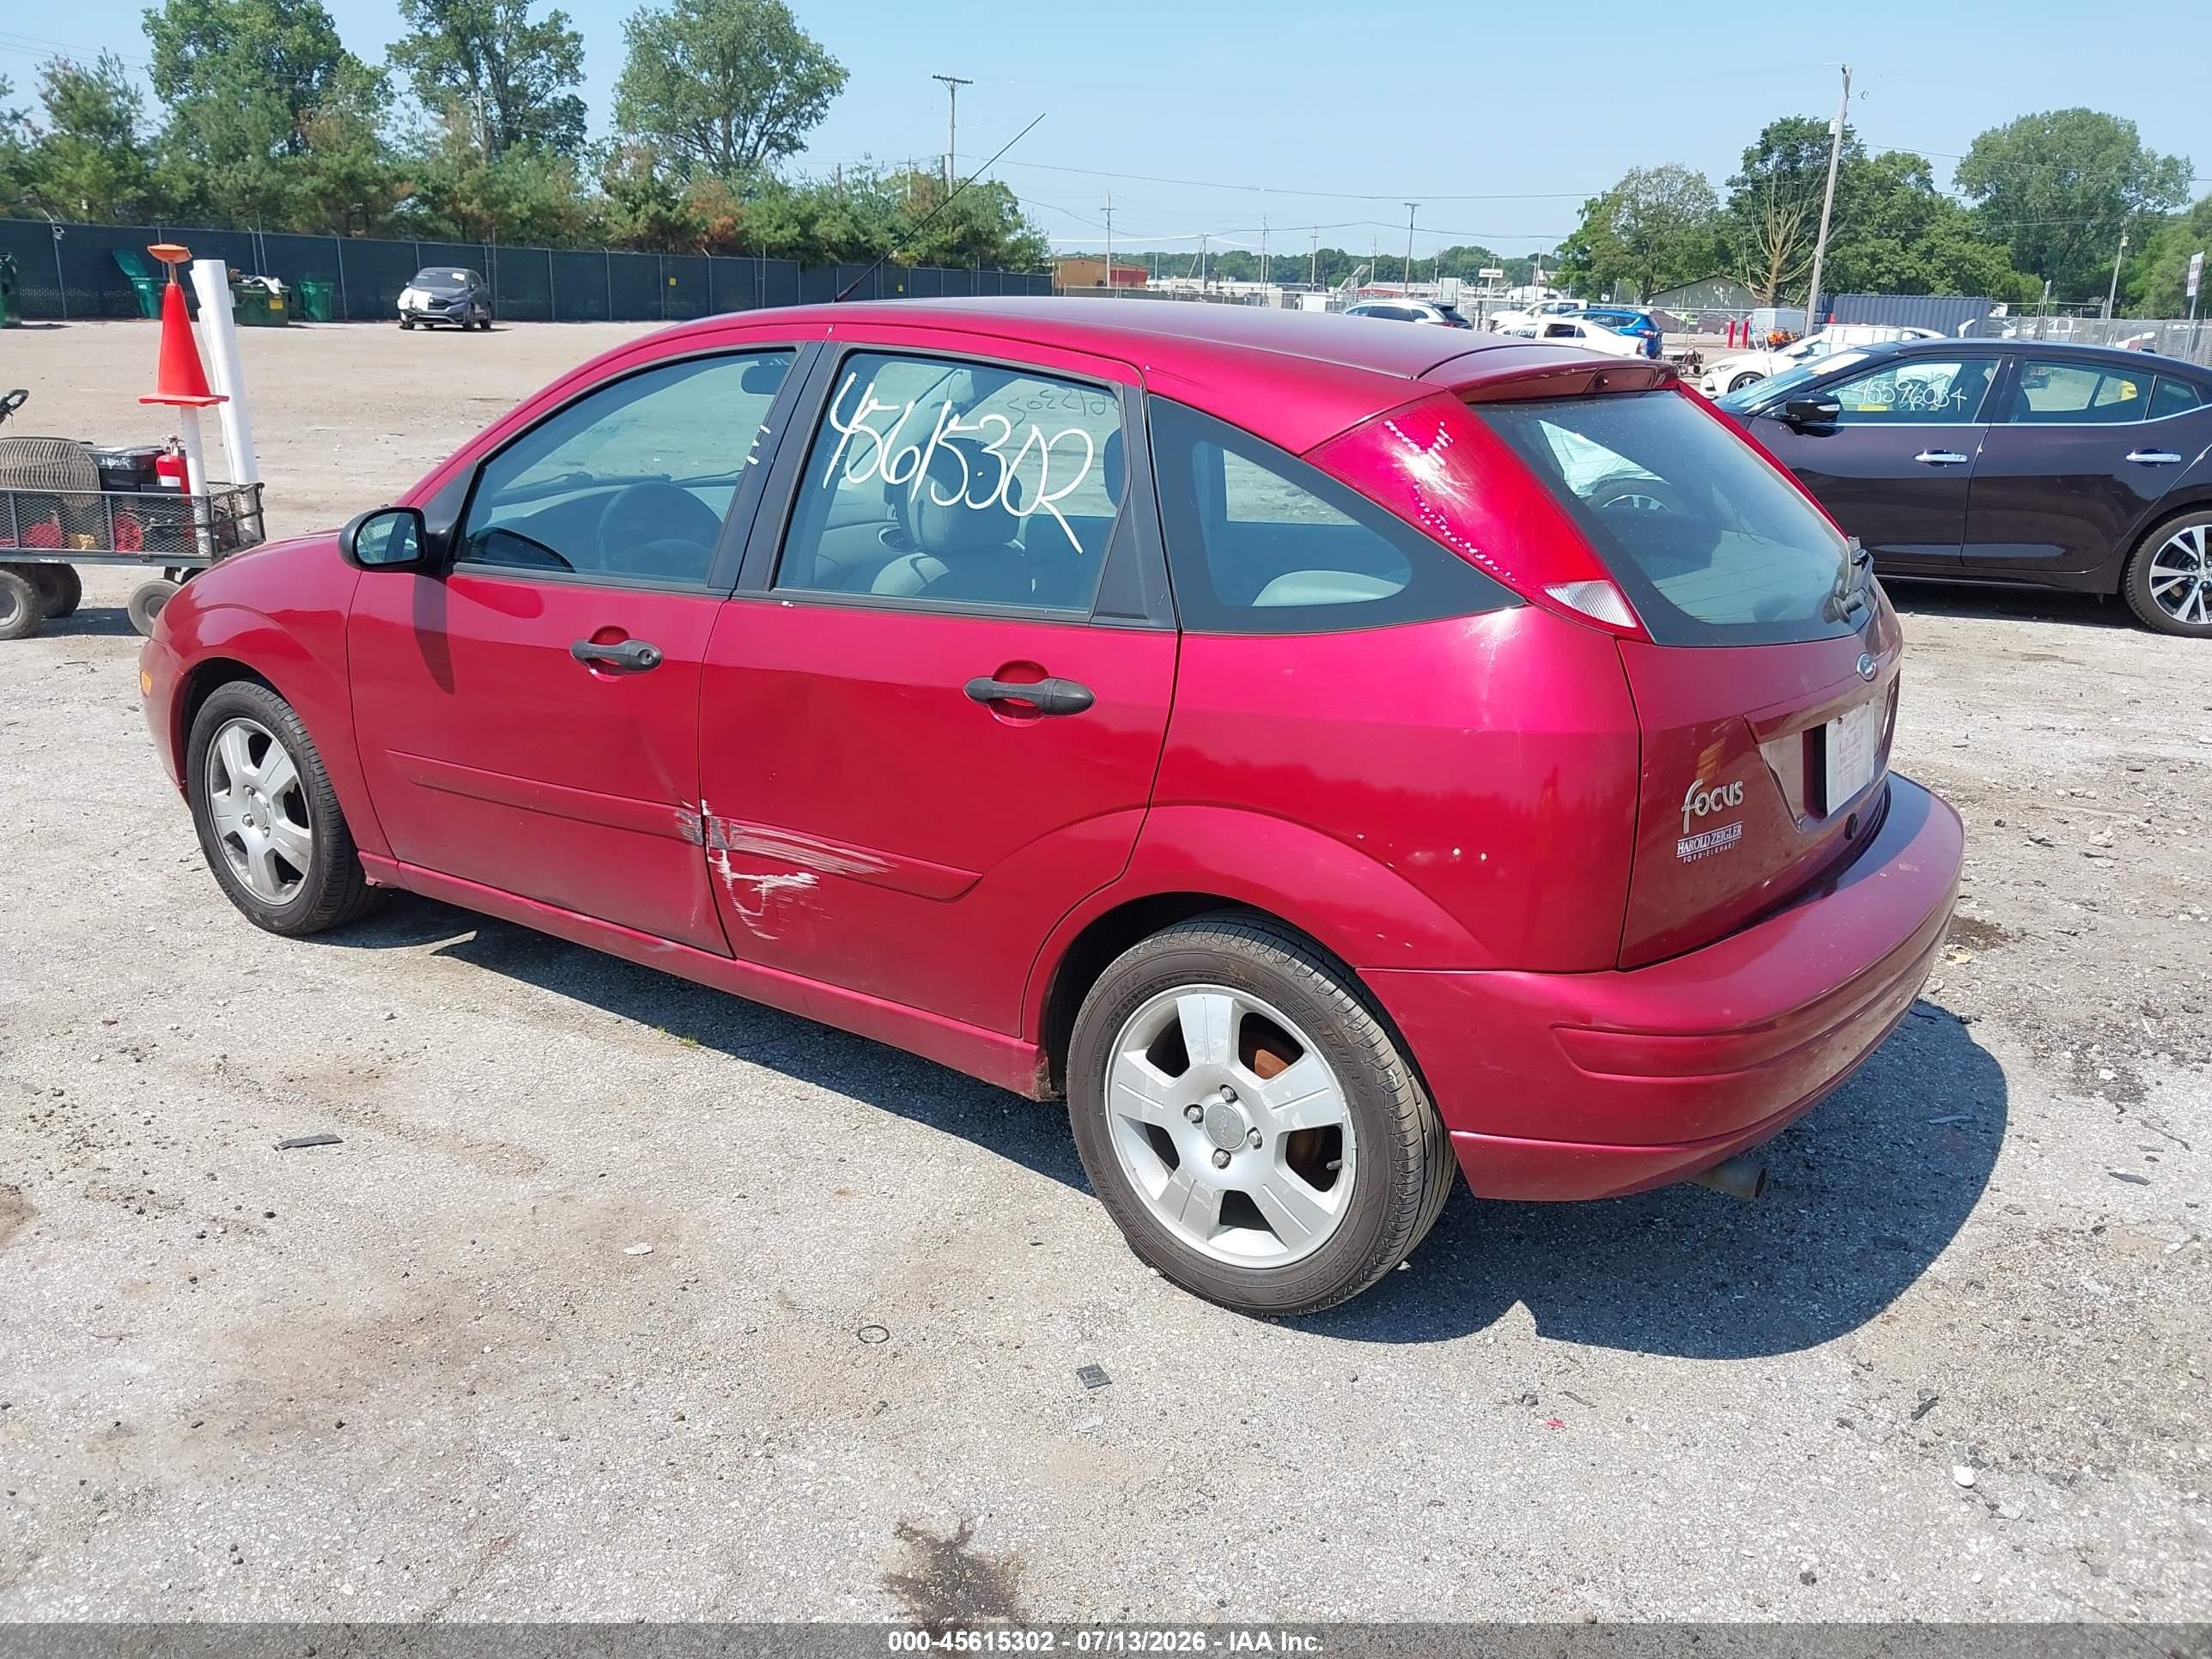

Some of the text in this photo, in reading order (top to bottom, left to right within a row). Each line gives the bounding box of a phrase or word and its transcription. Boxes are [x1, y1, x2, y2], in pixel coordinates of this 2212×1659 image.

[1852, 376, 1967, 412] 45596034
[1676, 823, 1742, 855] HAROLD ZEIGLER
